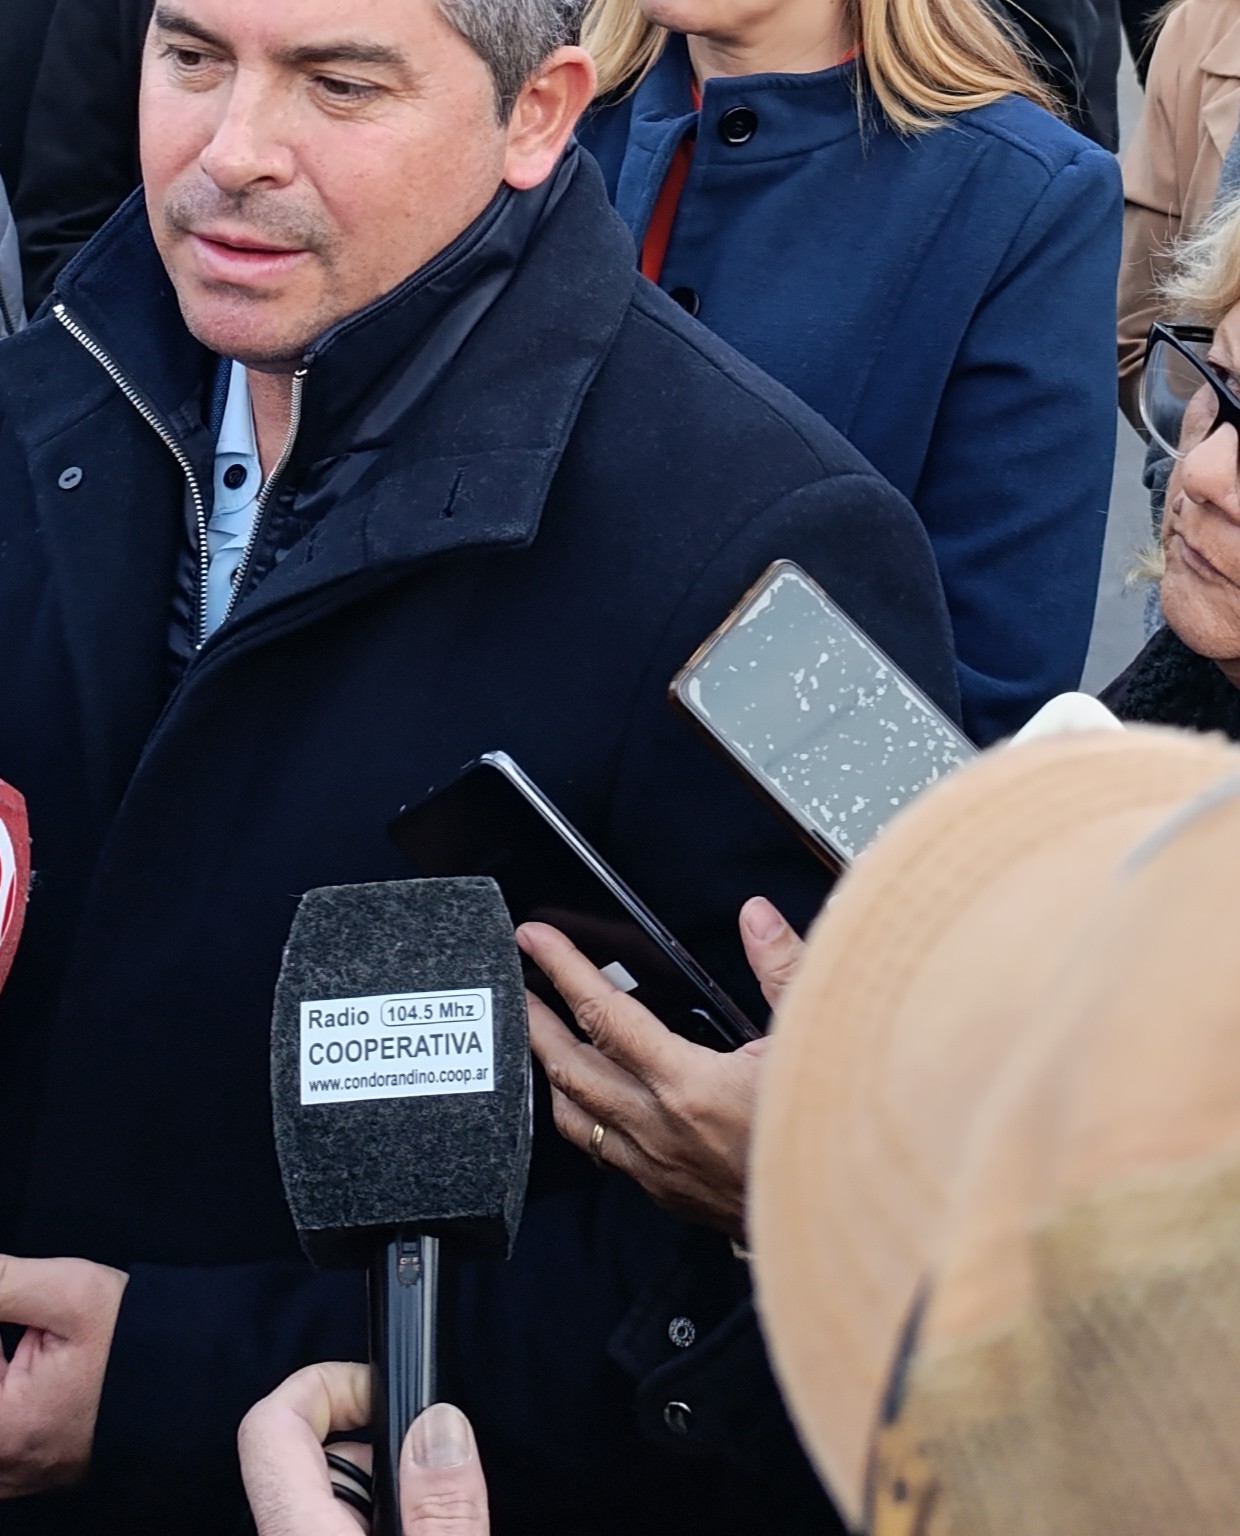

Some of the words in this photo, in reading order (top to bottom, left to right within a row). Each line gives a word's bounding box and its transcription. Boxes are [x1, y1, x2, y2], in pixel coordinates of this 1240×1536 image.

[308, 1006, 370, 1030] Radio
[387, 1003, 434, 1022] 104.5
[439, 1001, 475, 1018] Mhz
[308, 1030, 483, 1066] COOPERATIVA
[308, 1066, 489, 1093] www.condorandino.coop.ar
